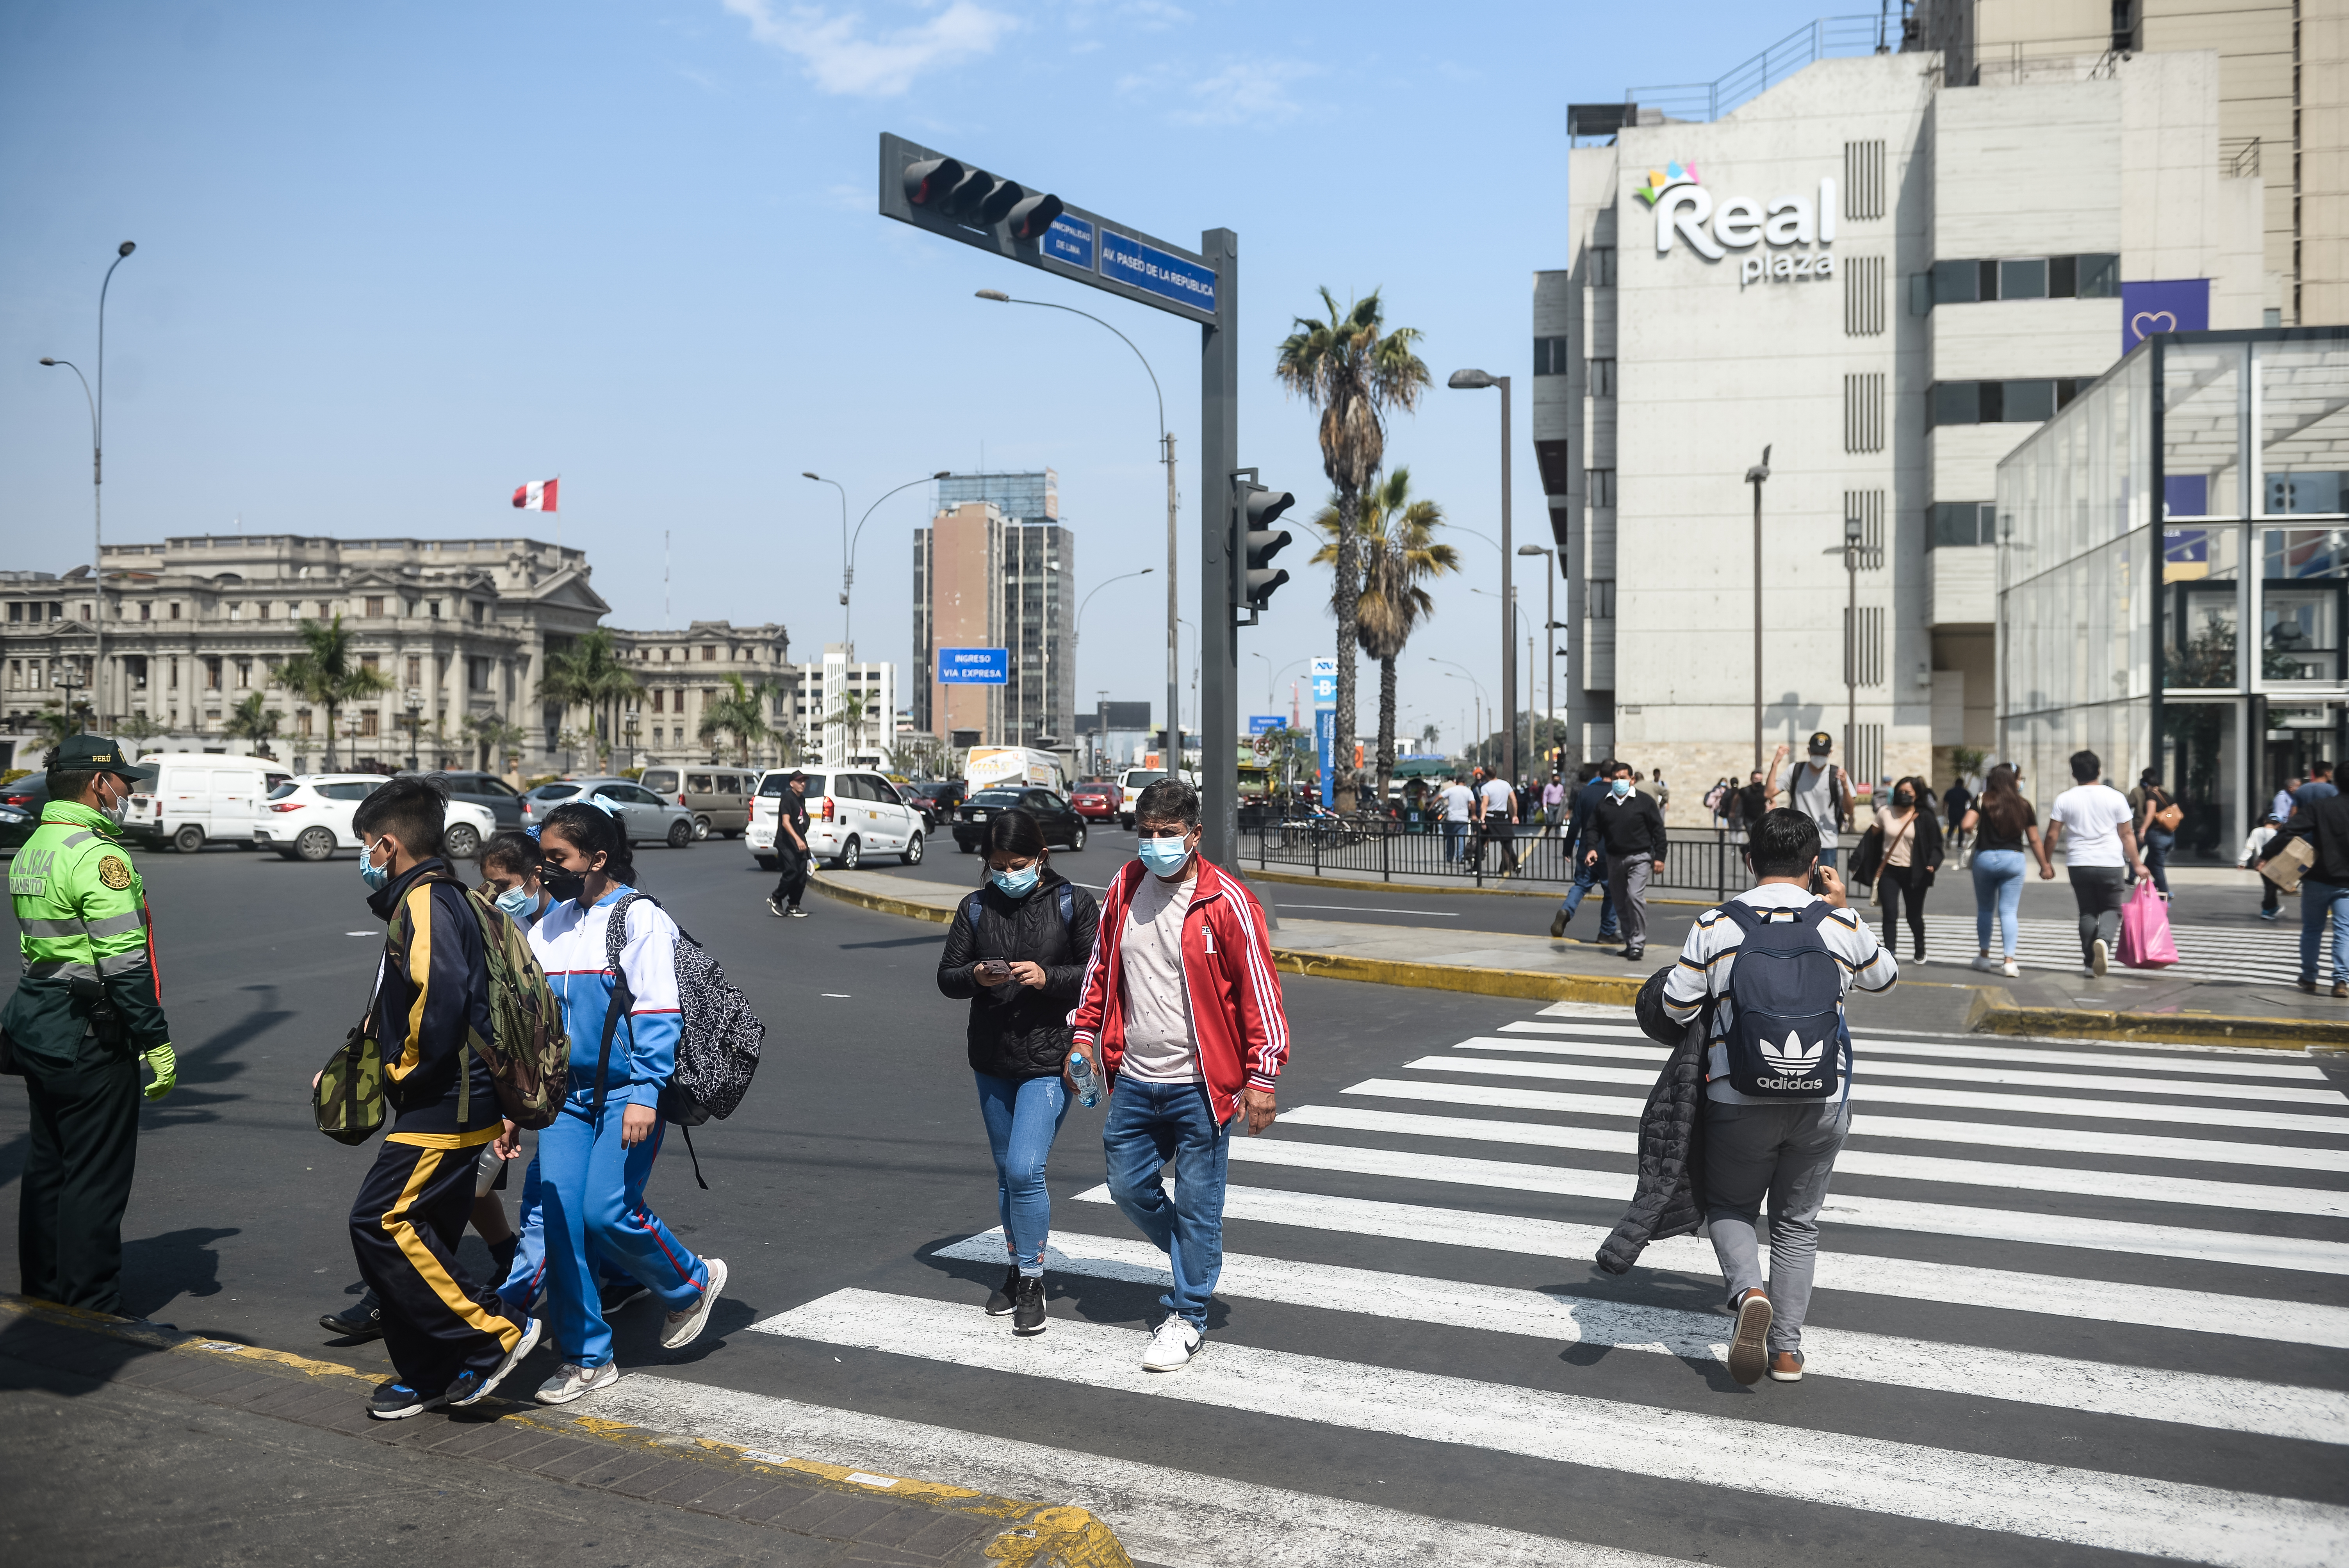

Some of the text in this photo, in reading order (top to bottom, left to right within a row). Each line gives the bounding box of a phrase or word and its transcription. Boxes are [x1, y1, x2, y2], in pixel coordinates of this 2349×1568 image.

[1657, 177, 1837, 259] Real
[1050, 221, 1092, 241] UNICIPALIDAD
[1056, 239, 1065, 250] DE
[1102, 248, 1214, 297] AV. PASEO DE LA REPÚBLICA
[1742, 250, 1835, 285] plaza
[955, 654, 991, 663] INGRESO
[943, 669, 1002, 678] VIA EXPRESA
[1319, 679, 1332, 696] B
[92, 754, 111, 762] PERÚ
[14, 849, 56, 877] OLICIA
[11, 878, 42, 894] RANSITO
[1757, 1077, 1823, 1090] adidas
